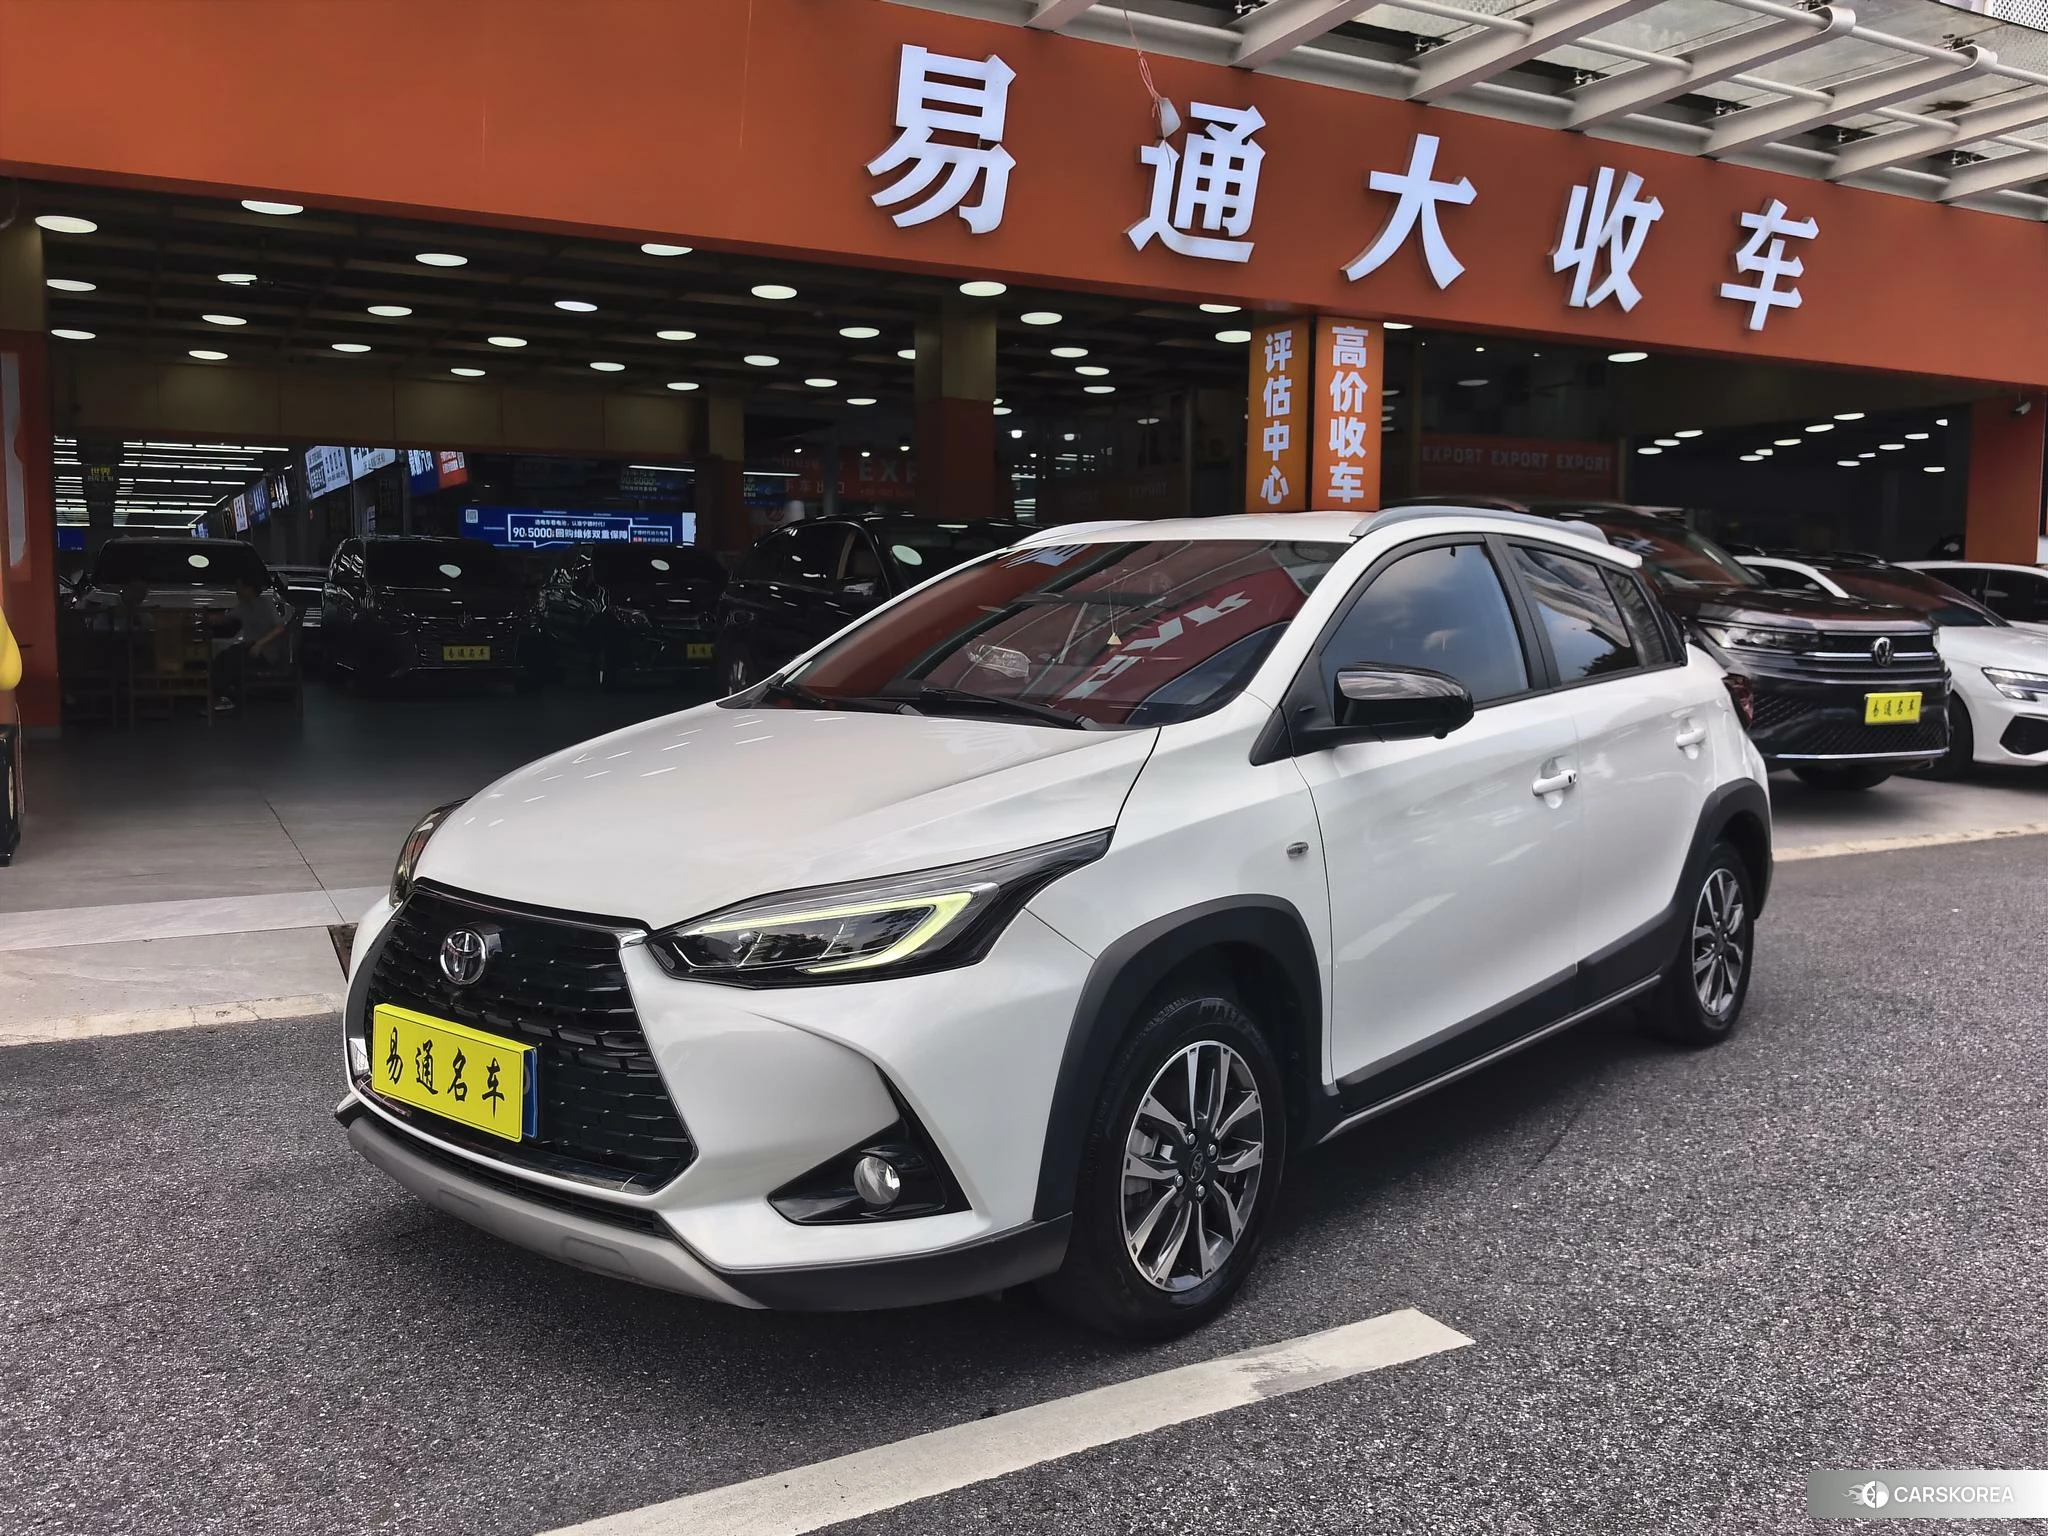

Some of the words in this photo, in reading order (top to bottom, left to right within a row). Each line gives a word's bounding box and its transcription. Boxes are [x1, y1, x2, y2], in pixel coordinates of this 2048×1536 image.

[865, 44, 1820, 331] 易通大收车
[1260, 329, 1293, 505] 评估中心
[1327, 326, 1369, 504] 高价收车
[1422, 446, 1483, 465] EXPORT
[1490, 449, 1549, 469] EXPORT
[1556, 453, 1612, 472] EXPORT
[385, 1026, 505, 1119] 易通名车
